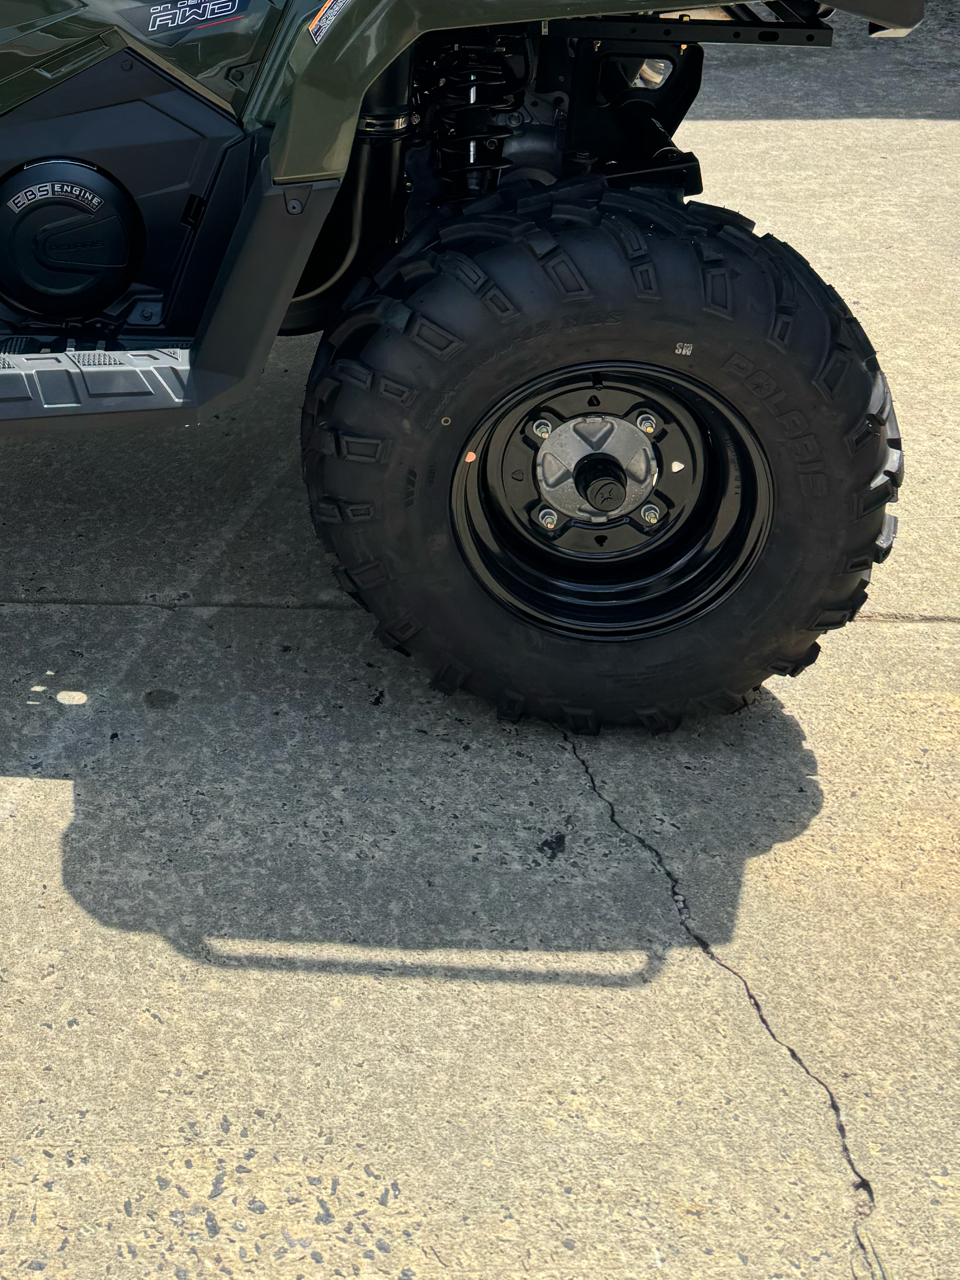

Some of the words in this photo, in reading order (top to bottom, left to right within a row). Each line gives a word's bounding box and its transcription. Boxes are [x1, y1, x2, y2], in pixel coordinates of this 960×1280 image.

[150, 4, 171, 13] ON
[11, 184, 50, 210] EBS
[54, 183, 102, 206] ENGINE
[720, 351, 830, 499] POLARIS
